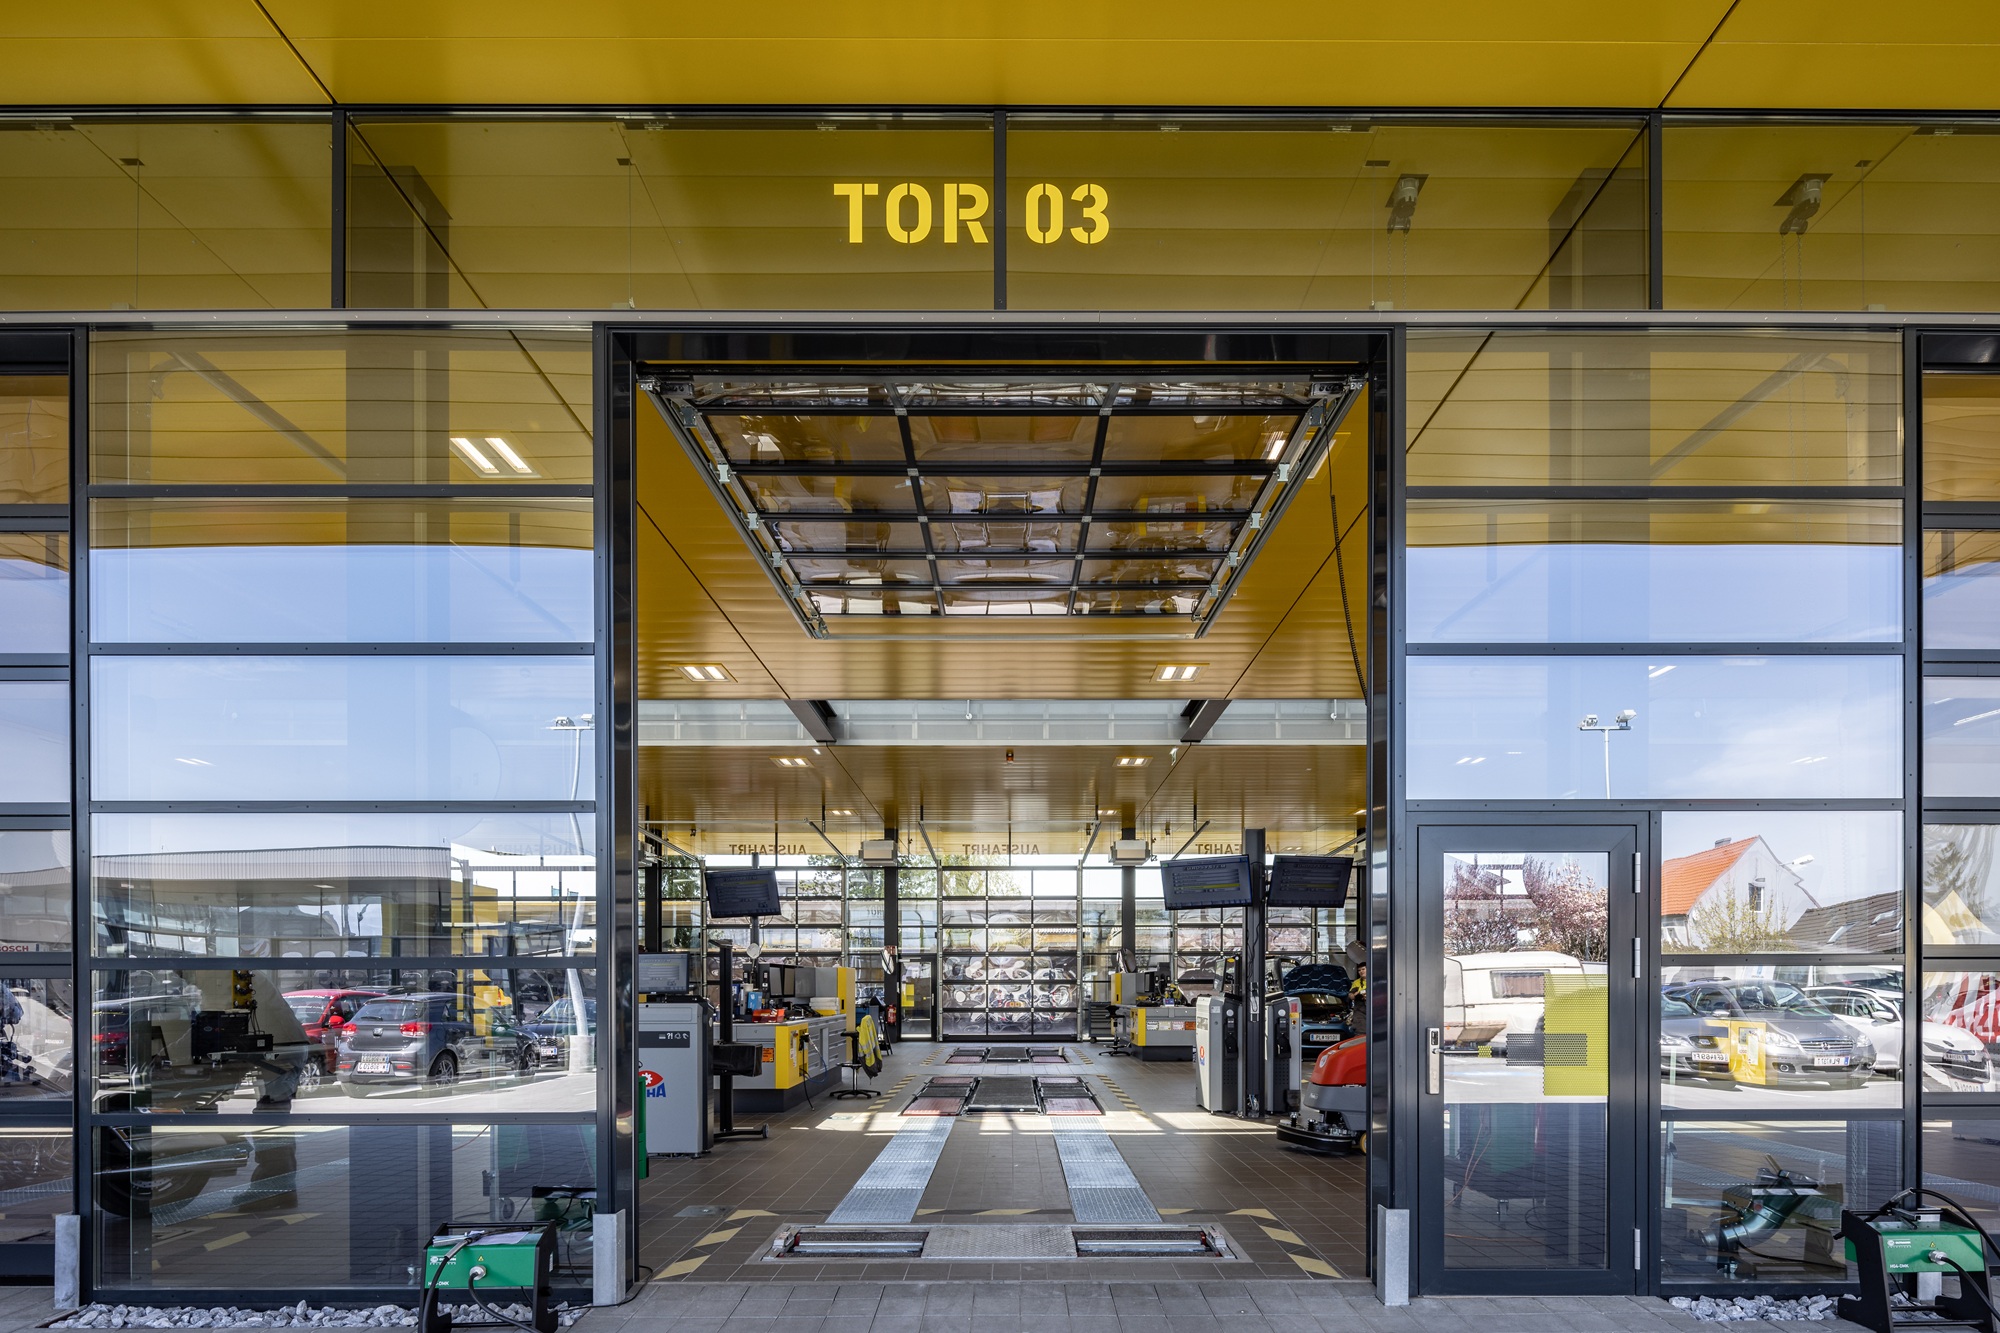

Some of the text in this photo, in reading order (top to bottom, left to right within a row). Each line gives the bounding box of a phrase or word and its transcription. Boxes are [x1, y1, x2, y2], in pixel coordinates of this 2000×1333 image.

[833, 183, 1110, 244] TOR 03
[647, 1082, 666, 1097] HA
